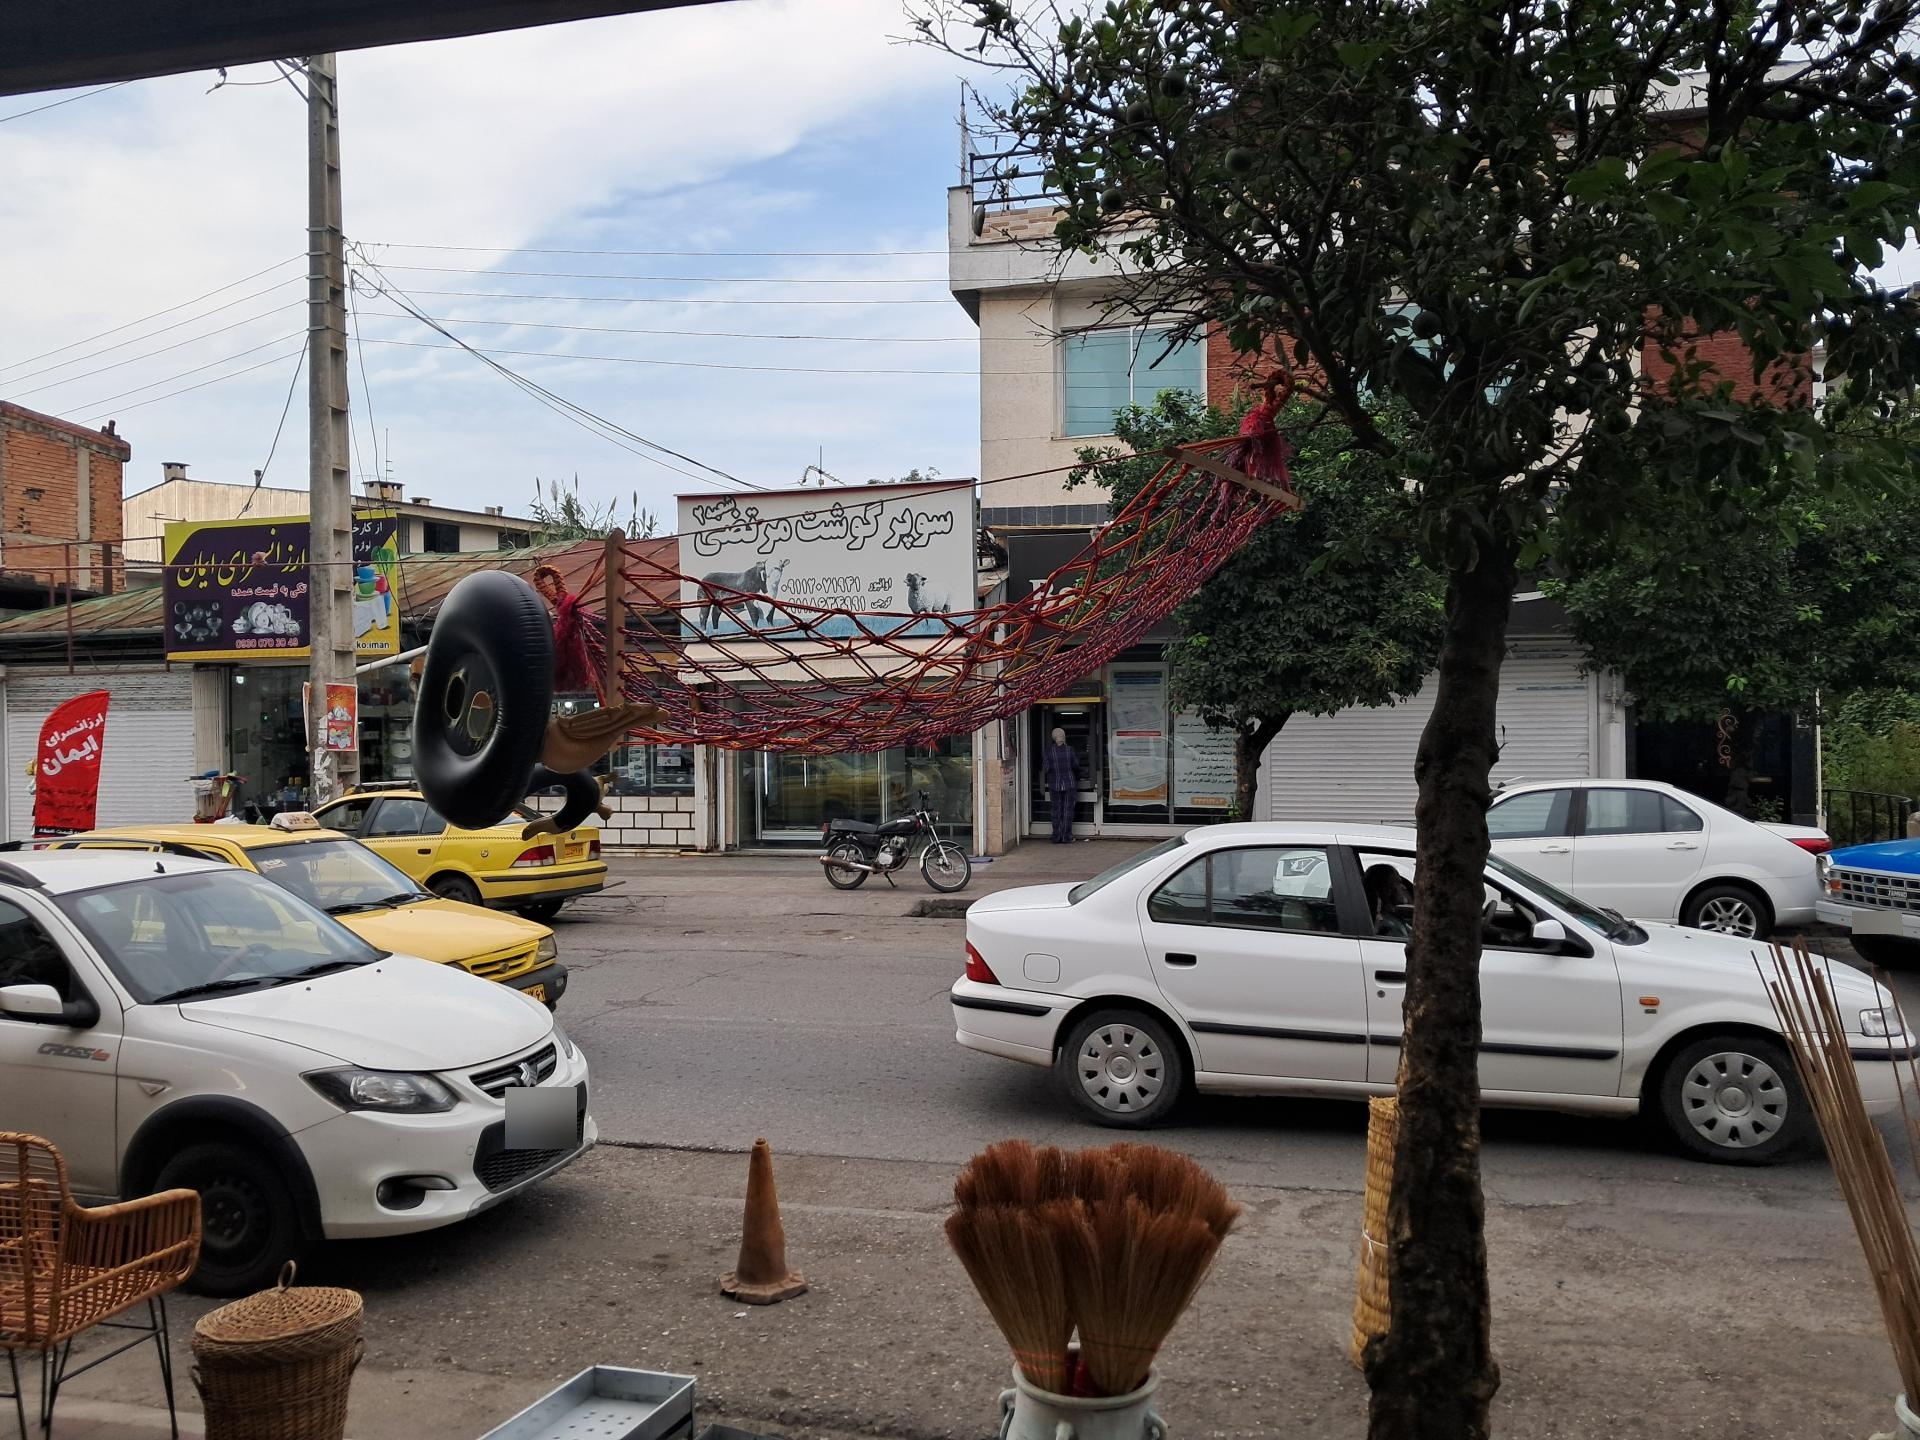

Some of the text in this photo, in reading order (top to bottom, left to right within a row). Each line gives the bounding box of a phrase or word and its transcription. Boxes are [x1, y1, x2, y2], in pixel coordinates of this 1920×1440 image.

[351, 521, 383, 535] از کارخ
[694, 500, 953, 556] سوپر گوشت مرتضی
[231, 582, 307, 598] تکی به قیمت عمده
[45, 712, 104, 747] ارزانسرای
[42, 734, 99, 776] ایمان
